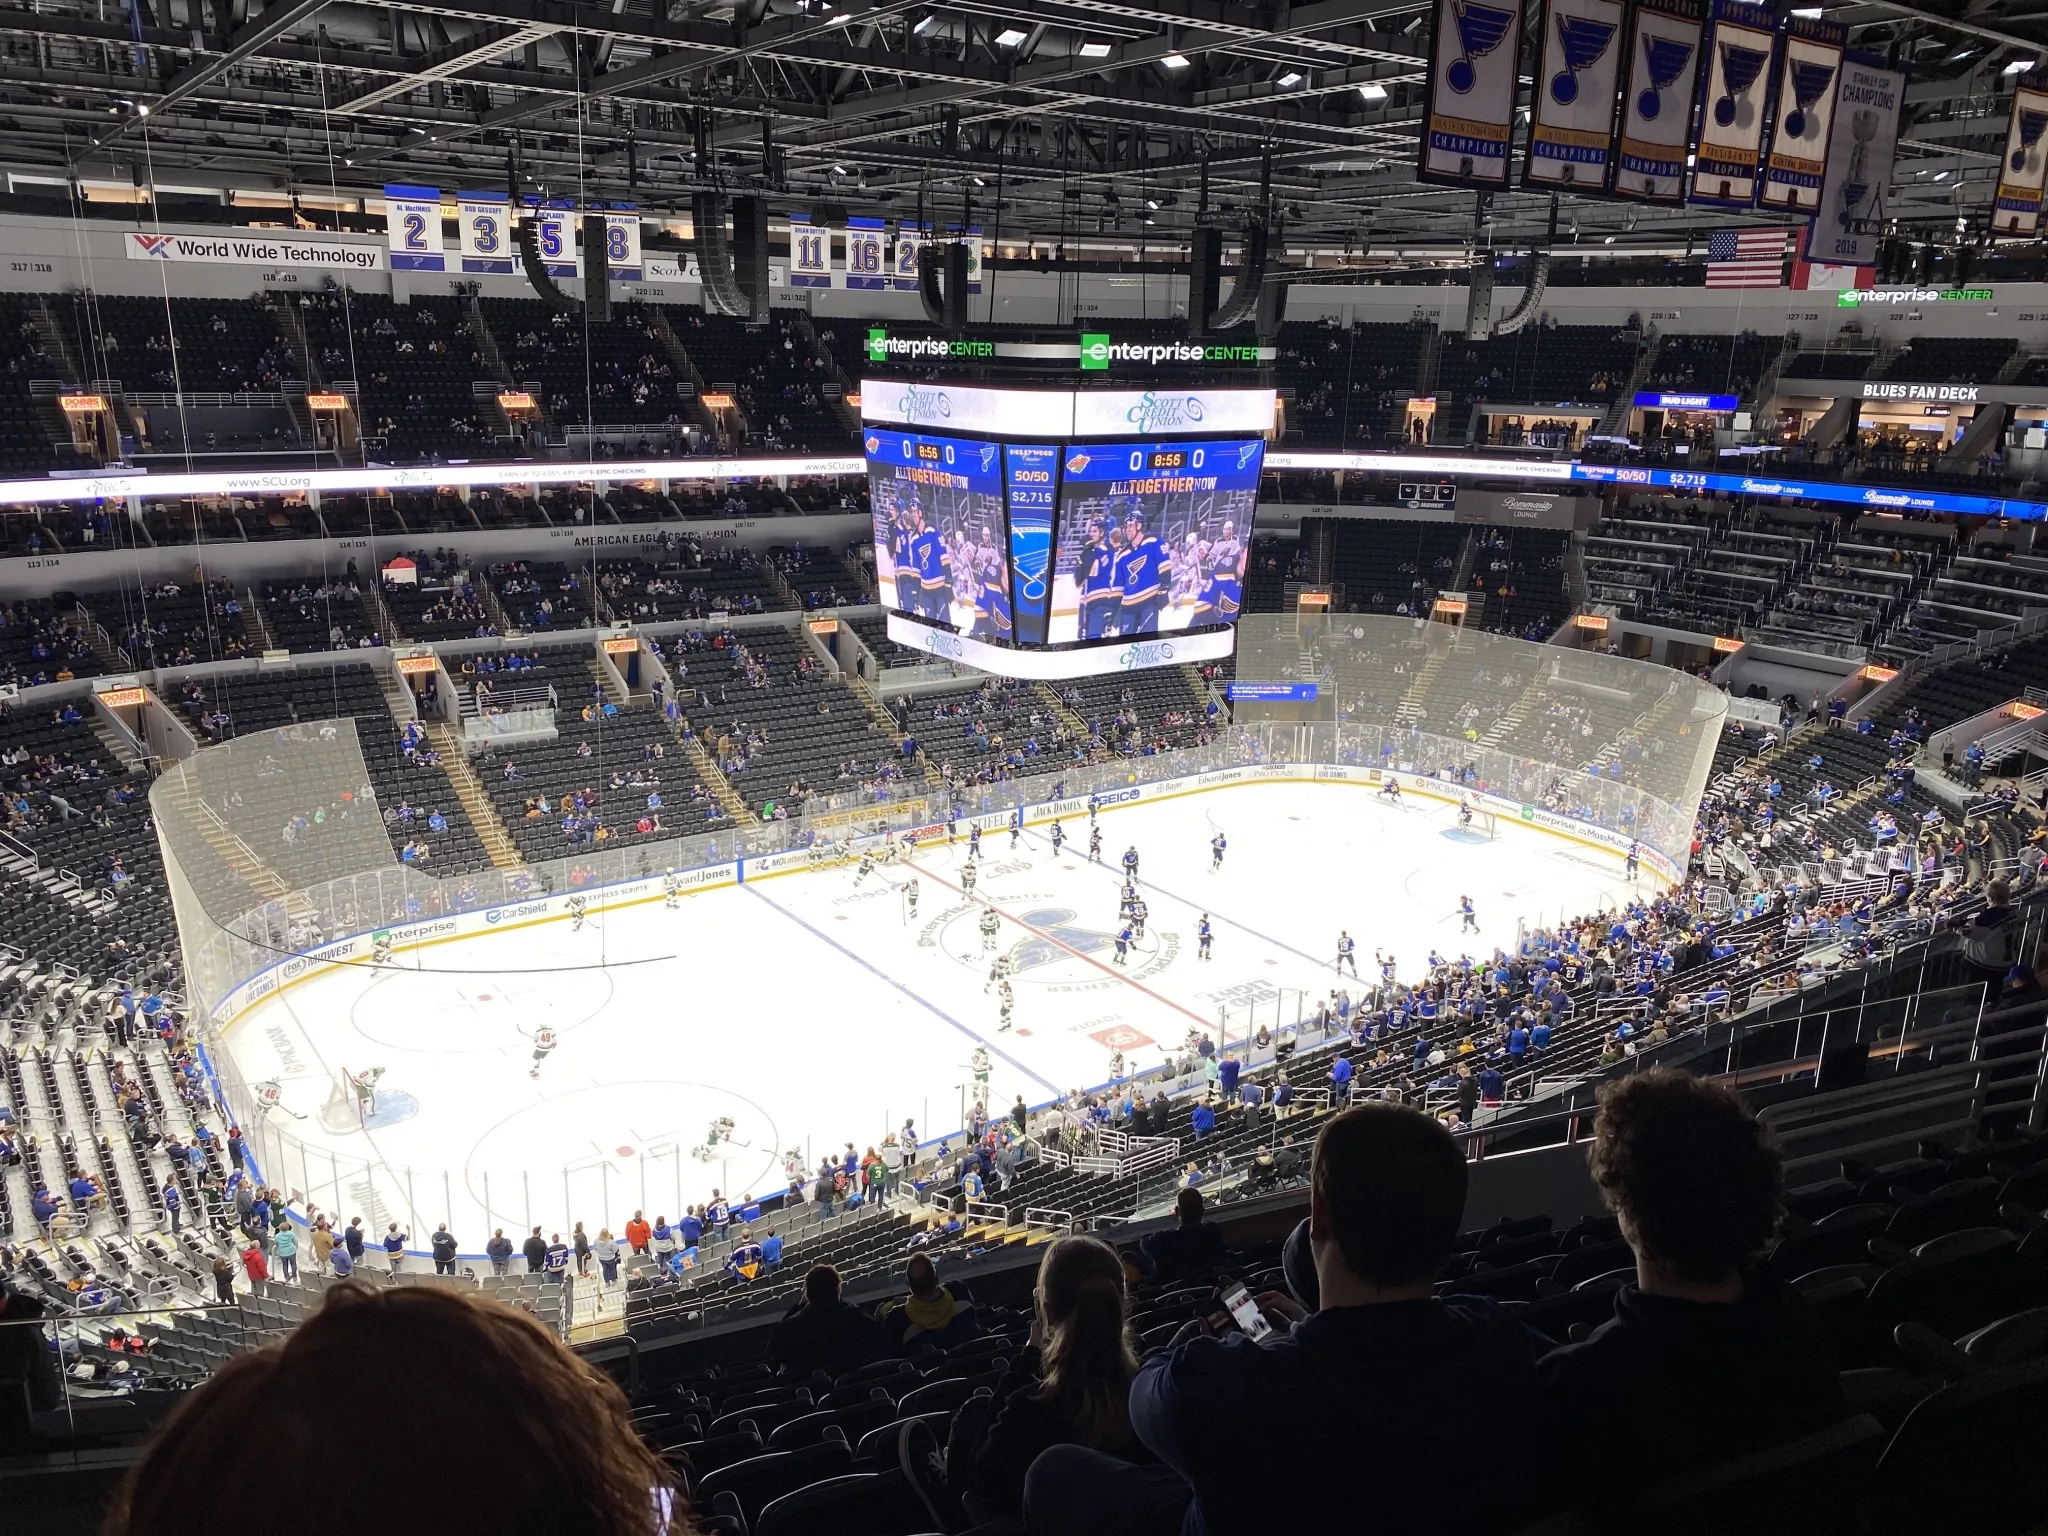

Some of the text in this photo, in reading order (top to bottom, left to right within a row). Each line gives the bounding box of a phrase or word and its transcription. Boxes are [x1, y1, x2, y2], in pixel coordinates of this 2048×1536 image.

[1842, 84, 1894, 109] CHAMPIONS
[1434, 136, 1504, 155] CHAMPIONS
[1539, 143, 1604, 161] CHAMPIONS
[1625, 156, 1679, 175] CHAMPIONS
[1710, 164, 1744, 176] TROPHY
[1770, 169, 1820, 186] CHAMPIONS
[404, 213, 427, 250] 2
[473, 215, 499, 253] 3
[540, 221, 562, 257] 5
[607, 225, 630, 261] 8
[177, 240, 376, 267] World Wide Technology
[798, 235, 825, 270] 11
[1836, 239, 1856, 254] 2019
[852, 239, 880, 274] 16
[11, 263, 52, 272] 317 318
[635, 288, 665, 296] 320 321
[1845, 289, 1993, 303] enterprise CENTER
[872, 336, 993, 358] enterprise CENTER
[1090, 341, 1259, 365] enterprise CENTER
[906, 384, 936, 402] SCOTT
[1863, 384, 1978, 401] BLUES FAN DECK
[65, 397, 98, 405] DOBBS
[1142, 391, 1184, 409] SCOTT
[1661, 396, 1709, 407] BUD LIGHT
[1126, 405, 1179, 423] CREDIT
[1138, 416, 1184, 435] UNION
[902, 440, 955, 464] 0 8:56 0
[805, 461, 861, 472] www.SCU.org
[1130, 449, 1205, 471] 0 8:56 0
[227, 475, 311, 488] www.SCU.org
[1014, 470, 1049, 483] 50/50
[1617, 471, 1706, 486] 50/50 $2,715
[1012, 491, 1052, 504] $2,715
[1783, 487, 1804, 495] LOUNGE
[1502, 496, 1553, 509] Bommarito
[1911, 497, 1935, 507] LOUNGE
[1514, 511, 1538, 519] LOUNGE
[574, 535, 628, 547] AMERICAN
[633, 533, 660, 543] EAGL
[27, 559, 59, 568] 113 114
[812, 622, 835, 630] DOBBS
[607, 640, 635, 649] DOBBS
[401, 659, 434, 669] DOBBS
[102, 690, 141, 703] DOBBS
[1164, 781, 1182, 792] Bayer
[1033, 804, 1052, 818] JACK
[1099, 789, 1140, 806] GEICO
[1587, 828, 1634, 849] MassMutua
[588, 890, 618, 901] EXPRESS
[502, 902, 547, 919] CarShield
[308, 942, 355, 967] MIDWEST
[287, 961, 301, 972] FOX
[541, 1033, 551, 1042] 49
[265, 1088, 276, 1100] 46
[875, 1169, 882, 1179] 3
[716, 1207, 728, 1220] 19
[551, 1256, 562, 1267] 17
